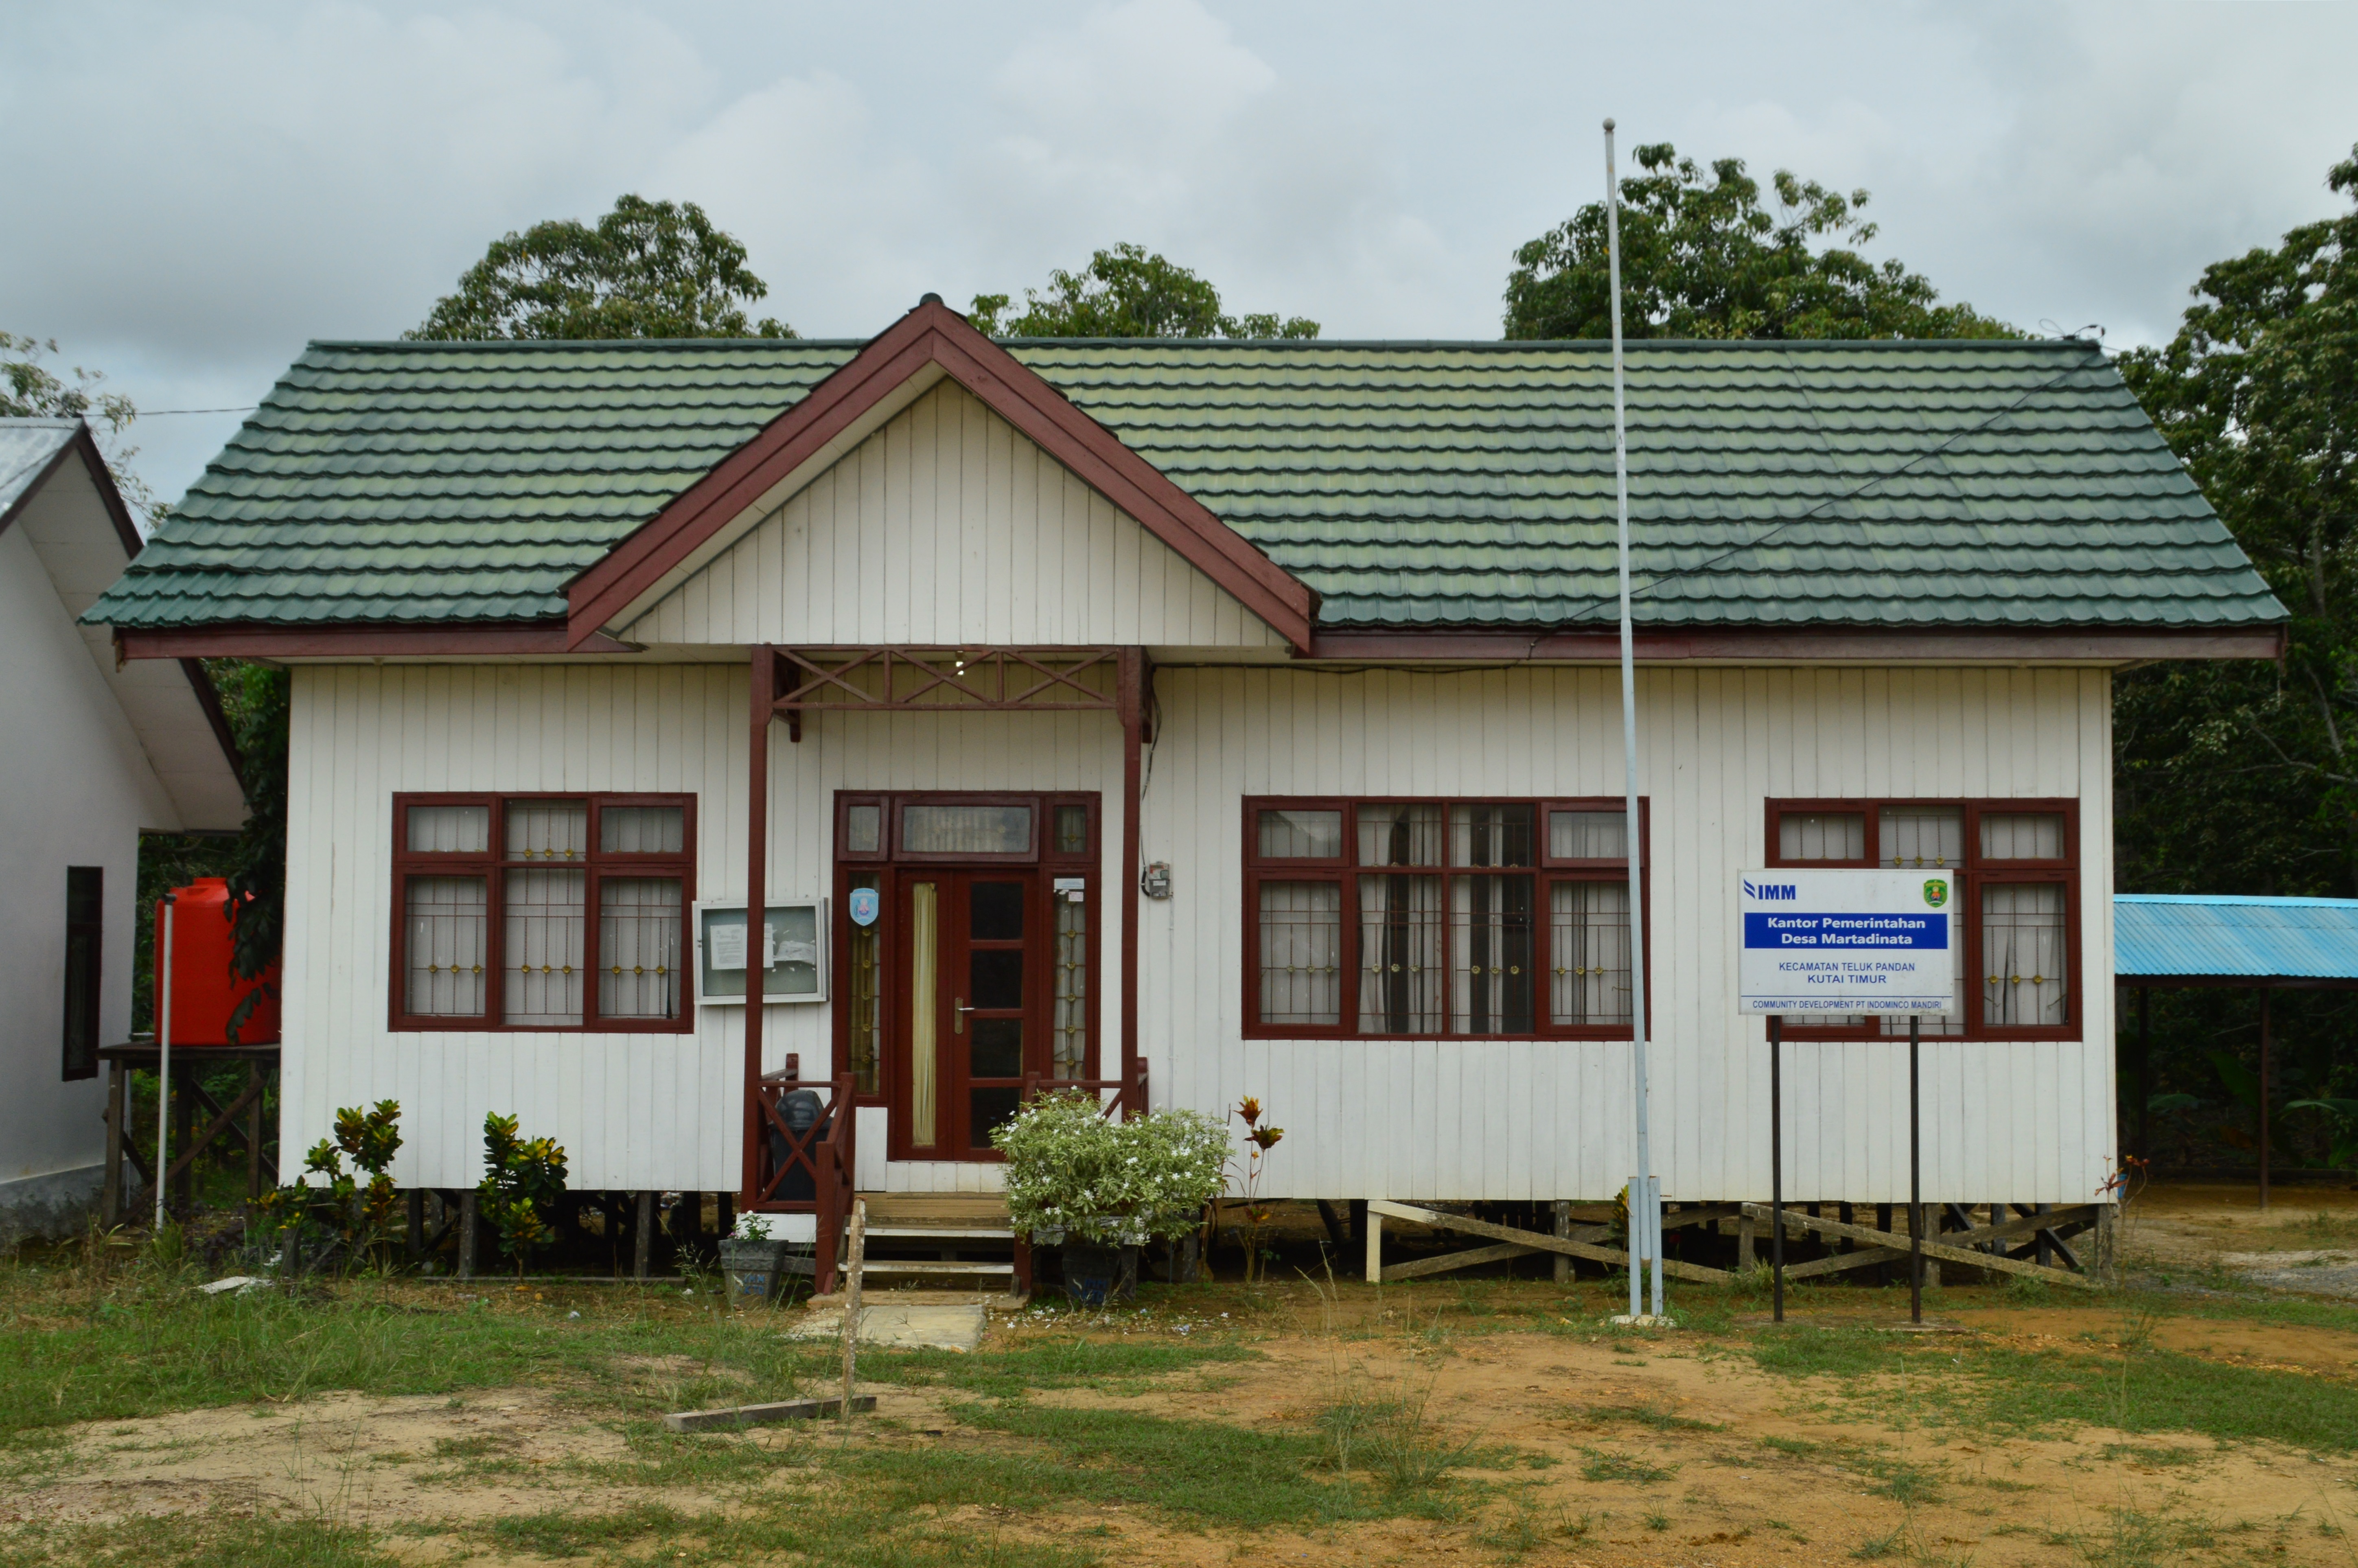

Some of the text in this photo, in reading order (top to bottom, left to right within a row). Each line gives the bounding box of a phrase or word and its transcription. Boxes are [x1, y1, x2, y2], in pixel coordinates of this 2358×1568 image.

[1758, 885, 1796, 900] IMM
[1767, 918, 1925, 929] Kantor Pemerintahan
[1781, 933, 1912, 944] Desa Martadinata
[1779, 962, 1915, 971] KECAMATAN TELUK PANDAN
[1808, 975, 1887, 983] KUTAI TIMUR
[1752, 1000, 1942, 1009] COMMUNITY DEVELOPMENT PT INDOMINCO MANDIRI
